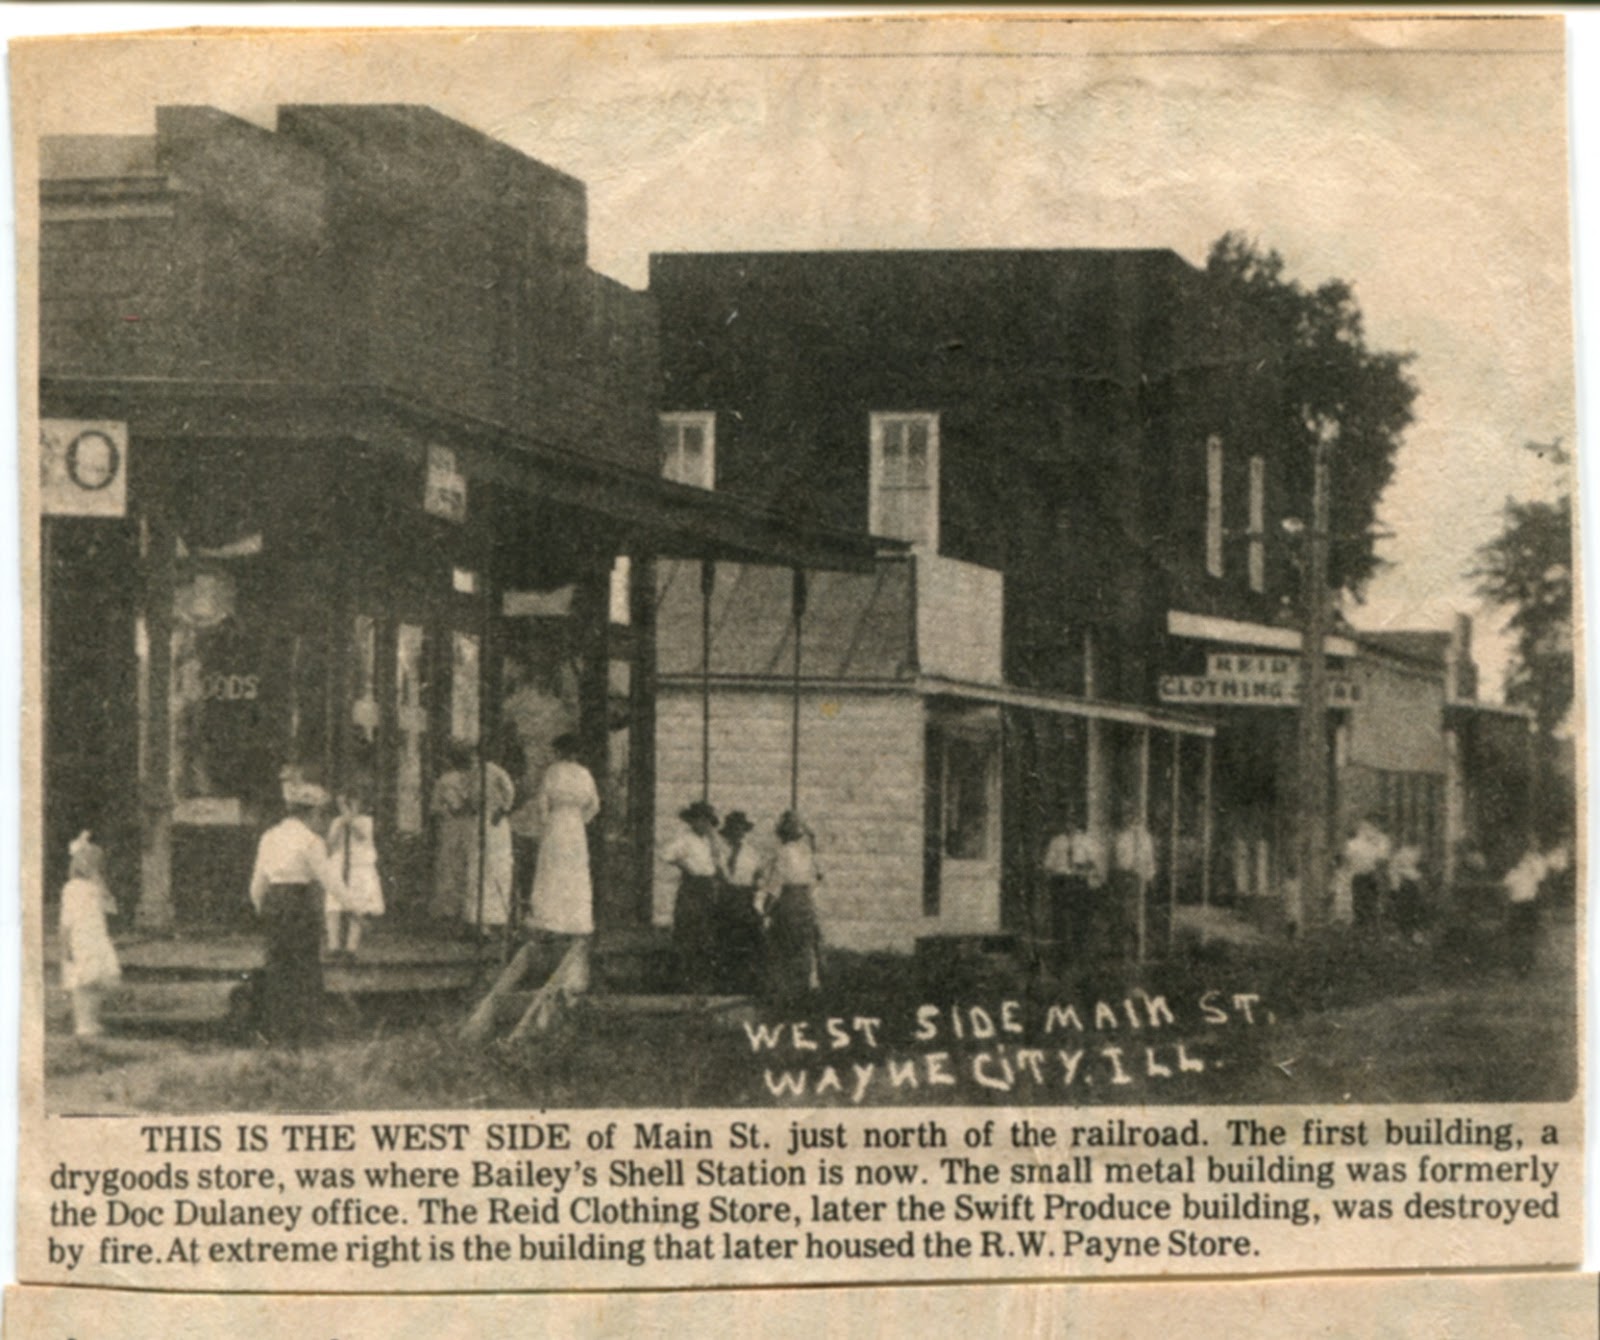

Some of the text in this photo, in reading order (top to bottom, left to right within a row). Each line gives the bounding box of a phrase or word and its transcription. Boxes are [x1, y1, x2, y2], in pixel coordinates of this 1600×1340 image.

[190, 674, 260, 701] OODS
[1160, 678, 1284, 699] CLOTHING
[743, 1016, 880, 1051] WEST
[915, 1000, 1023, 1040] SIDE
[1046, 994, 1175, 1033] MAIN
[764, 1051, 955, 1101] WAYNE
[140, 1117, 1559, 1157] THIS IS THE WEST SIDE of Main St. just north of the railroad. The first building, a
[49, 1153, 1560, 1197] drygoods store, was where Bailey's Shell Station is now. The small metal building was formerly
[49, 1190, 1560, 1233] the Doc Dulaney office. The Reid Clothing Store, later the Swift Produce building, was destroyed
[47, 1236, 85, 1271] by
[207, 1237, 339, 1263] extreme
[345, 1234, 422, 1269] right
[428, 1234, 456, 1262] is
[462, 1233, 512, 1262] the
[518, 1232, 647, 1268] building
[653, 1232, 716, 1261] that
[722, 1231, 800, 1261] later
[805, 1230, 916, 1260] housed
[922, 1230, 973, 1259] the
[979, 1230, 1055, 1259] R.W.
[1062, 1229, 1162, 1264] Payne
[1167, 1229, 1260, 1257] Store.
